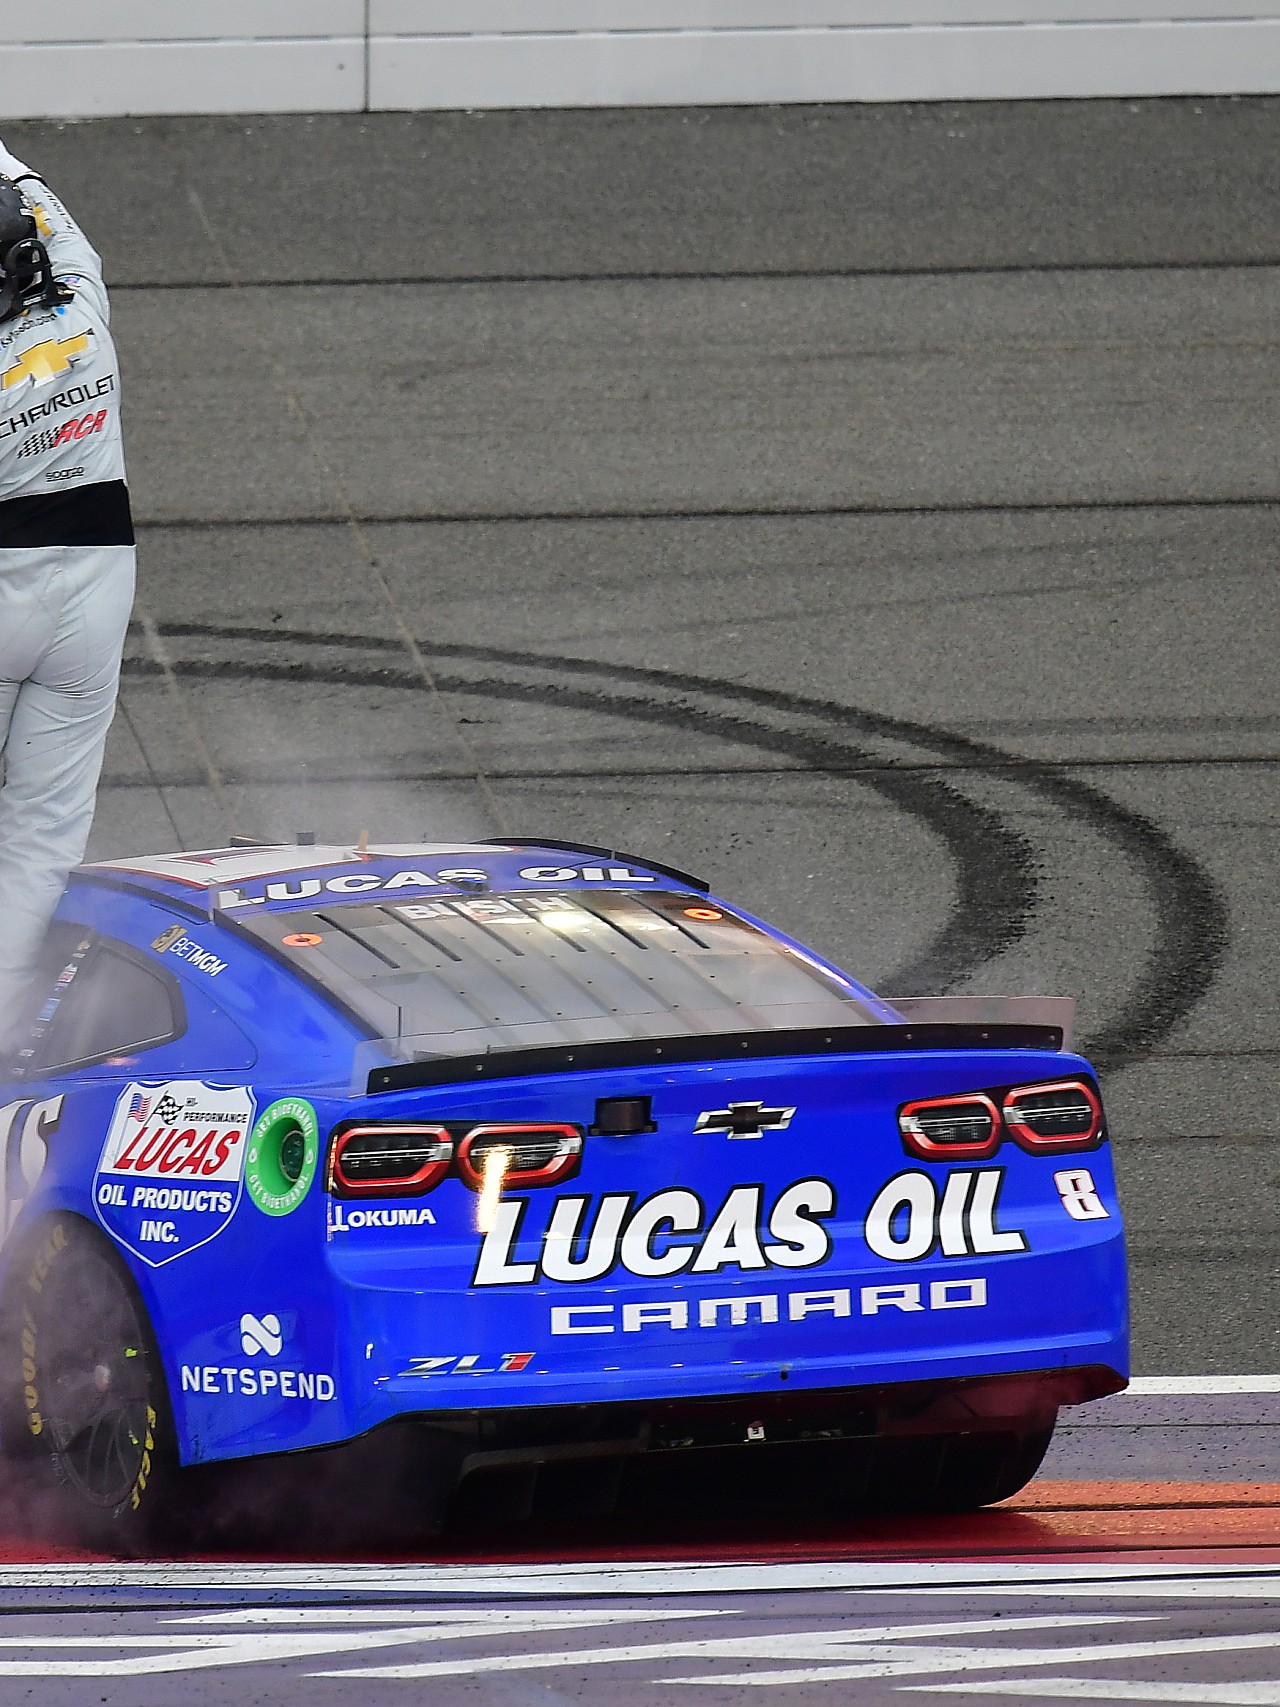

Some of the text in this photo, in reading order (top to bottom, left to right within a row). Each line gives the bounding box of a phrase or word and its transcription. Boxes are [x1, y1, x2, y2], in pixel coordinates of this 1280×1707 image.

[51, 409, 107, 449] RCR
[219, 865, 657, 910] LUCAS OIL
[169, 936, 229, 978] BETMGM
[183, 1111, 249, 1124] PERFORMANCE
[113, 1127, 242, 1176] LUCAS
[98, 1183, 233, 1214] OIL PRODUCTS
[1053, 1168, 1111, 1221] 8
[139, 1220, 180, 1244] INC.
[472, 1167, 1030, 1288] LUCAS OIL
[550, 1278, 988, 1336] CAMARO
[181, 1366, 336, 1401] NETSPEND
[397, 1352, 536, 1377] ZL1
